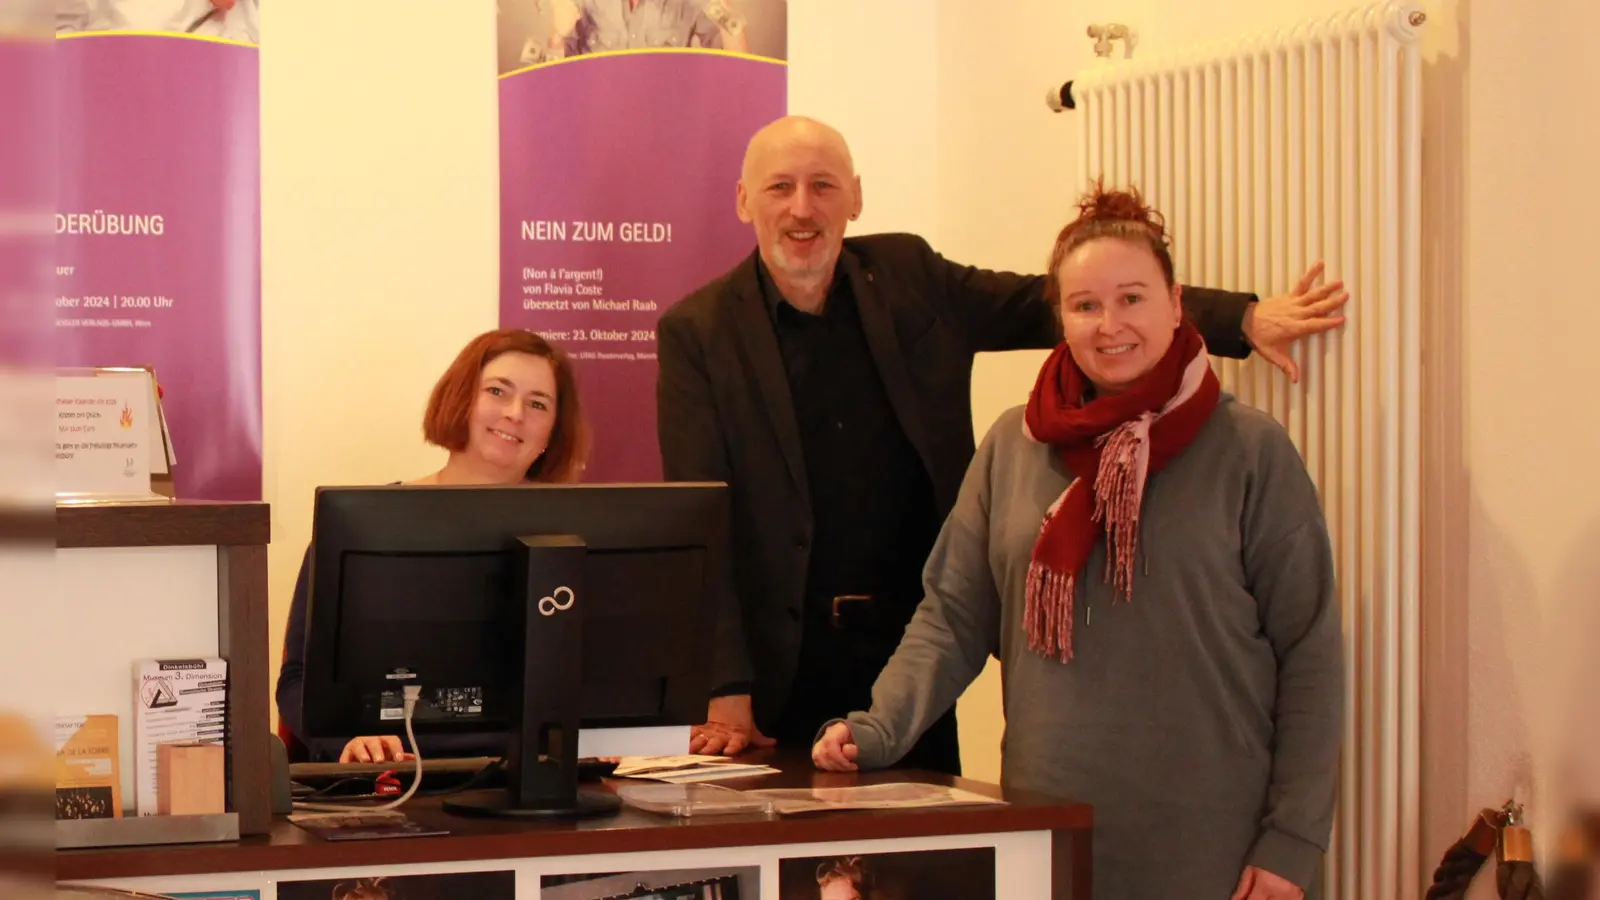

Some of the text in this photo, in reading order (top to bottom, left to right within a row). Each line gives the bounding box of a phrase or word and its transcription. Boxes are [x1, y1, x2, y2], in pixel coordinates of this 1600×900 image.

[521, 220, 673, 243] NEIN ZUM GELD!
[522, 267, 548, 281] (Non
[522, 283, 603, 296] von Flavia Coste
[83, 296, 110, 308] 2024
[120, 296, 151, 309] 20.00
[153, 295, 175, 309] Uhr
[522, 298, 658, 312] übersetzt von Michael Raab
[572, 329, 588, 341] 23.
[590, 329, 629, 342] Oktober
[631, 330, 656, 341] 2024
[162, 663, 204, 671] Dinkelsbühl
[143, 673, 173, 681] Museum
[175, 671, 184, 680] 3.
